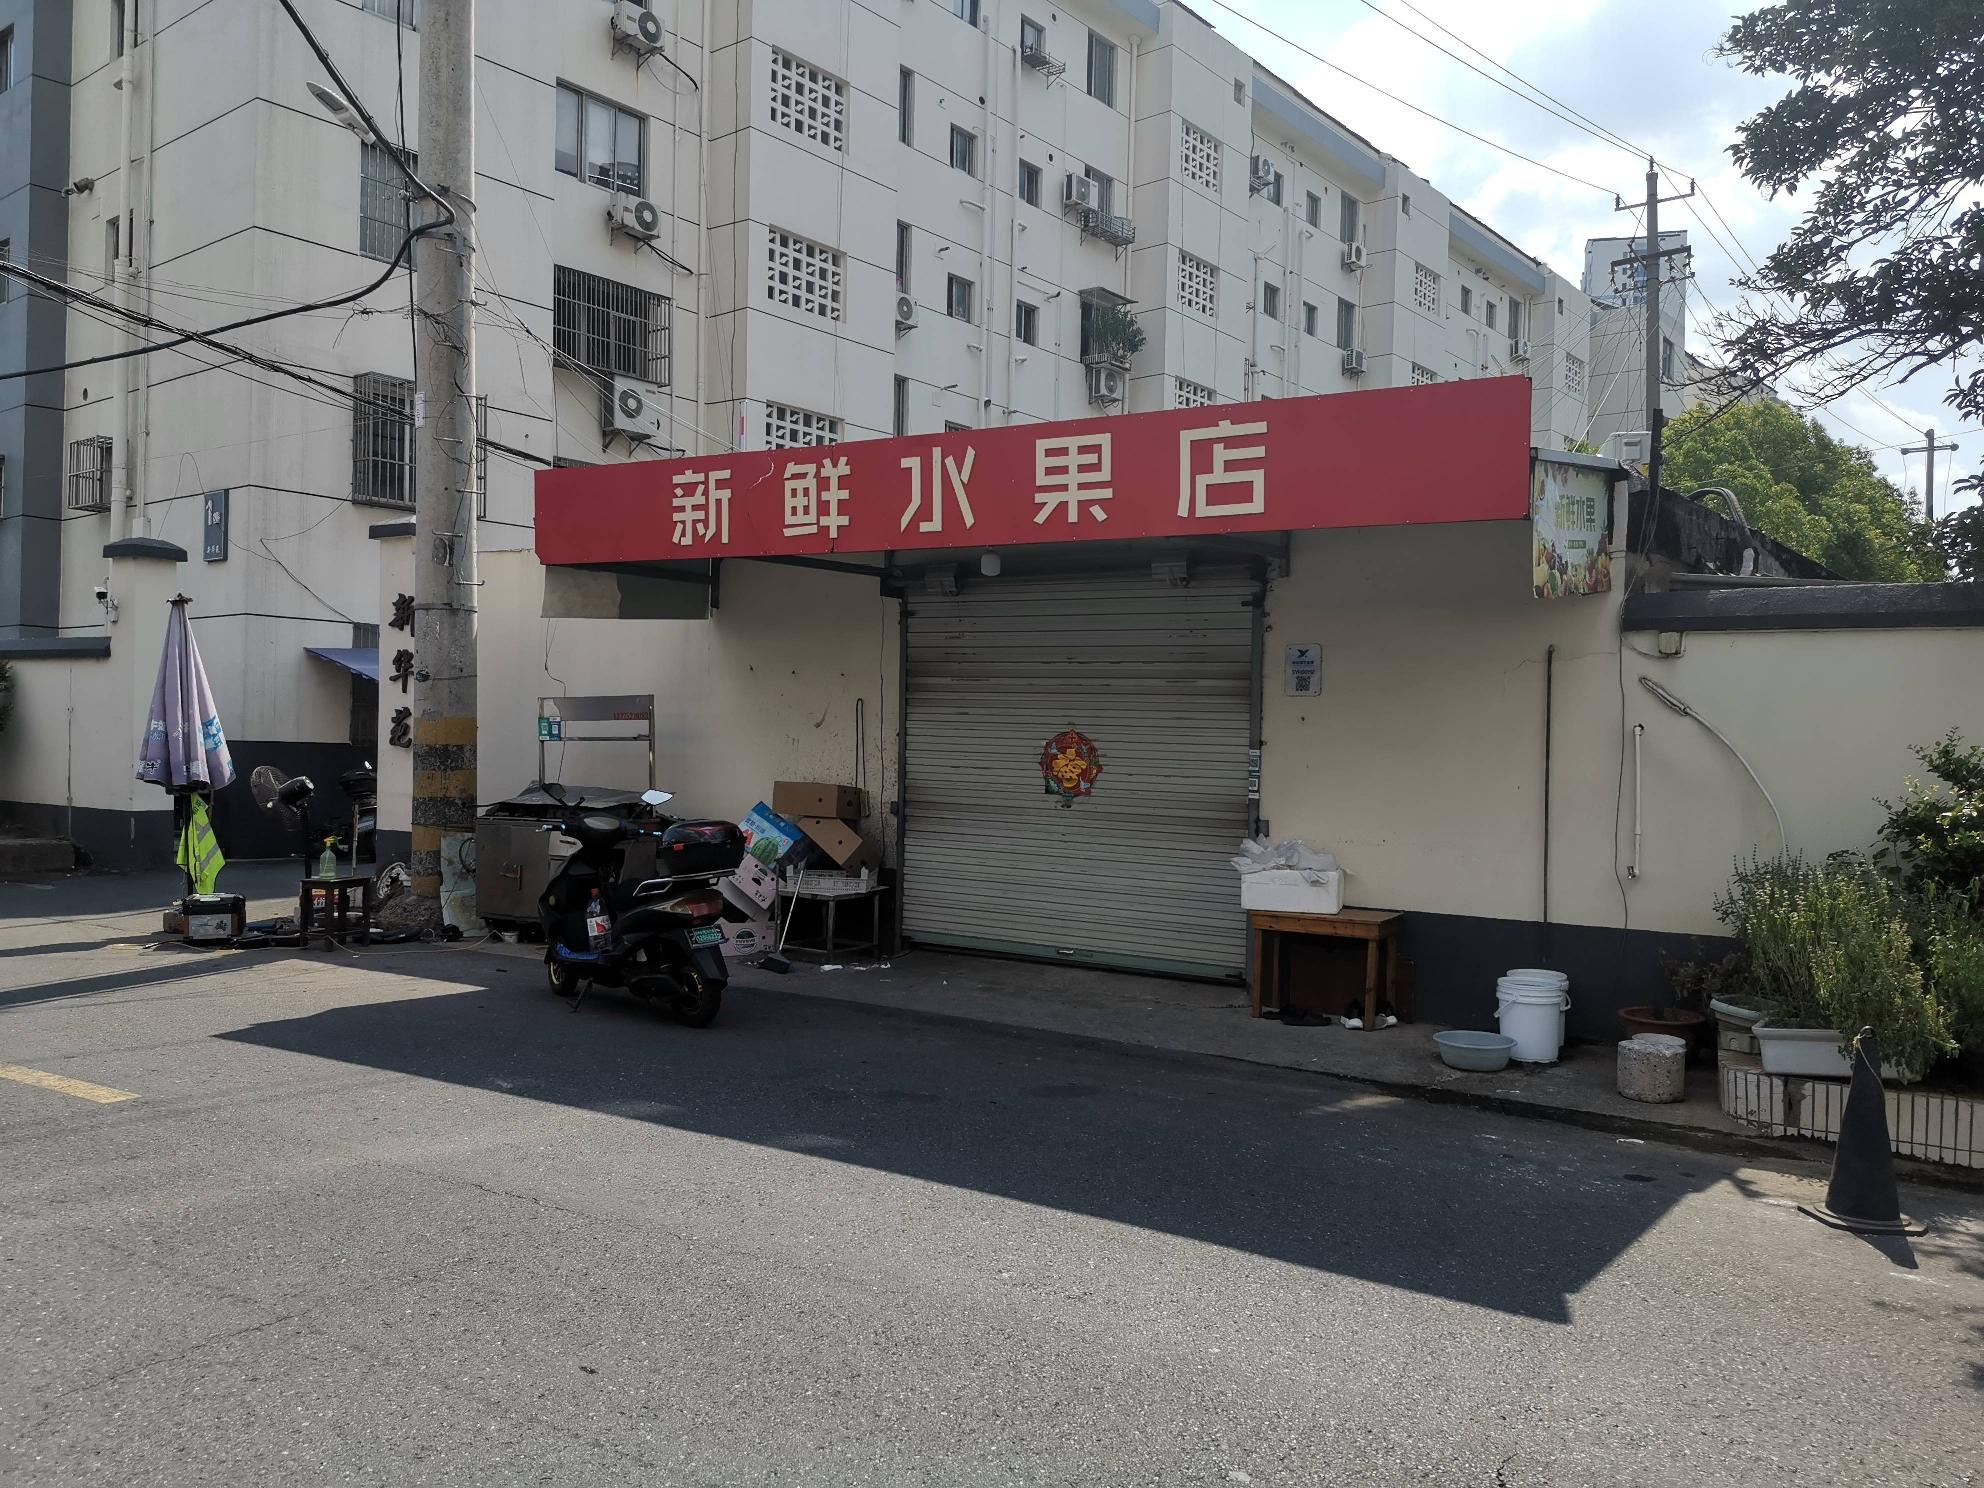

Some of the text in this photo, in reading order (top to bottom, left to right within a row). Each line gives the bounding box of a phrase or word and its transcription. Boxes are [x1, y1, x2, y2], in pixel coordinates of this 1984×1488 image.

[671, 419, 1268, 546] 新鲜水果店
[1554, 494, 1596, 532] 新鲜水果
